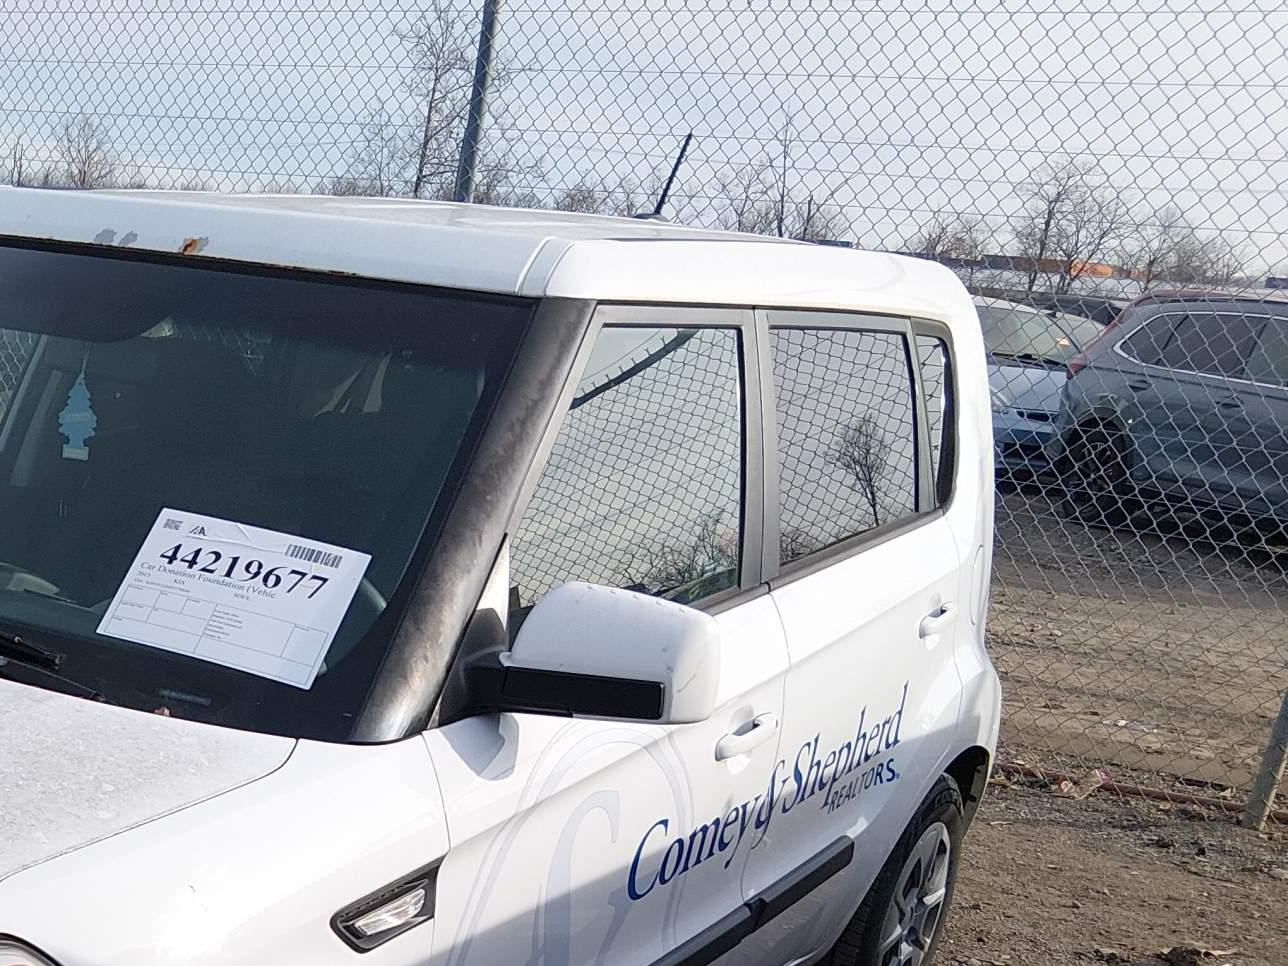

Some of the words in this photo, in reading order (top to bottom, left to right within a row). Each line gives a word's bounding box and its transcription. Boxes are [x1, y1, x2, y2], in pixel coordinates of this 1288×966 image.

[140, 561, 156, 571] Car
[158, 564, 195, 580] Donation
[197, 574, 245, 591] Foundation
[246, 584, 277, 599] (Vehic
[160, 543, 329, 599] 44219677
[627, 793, 760, 901] Comey
[781, 679, 909, 815] Shepherd
